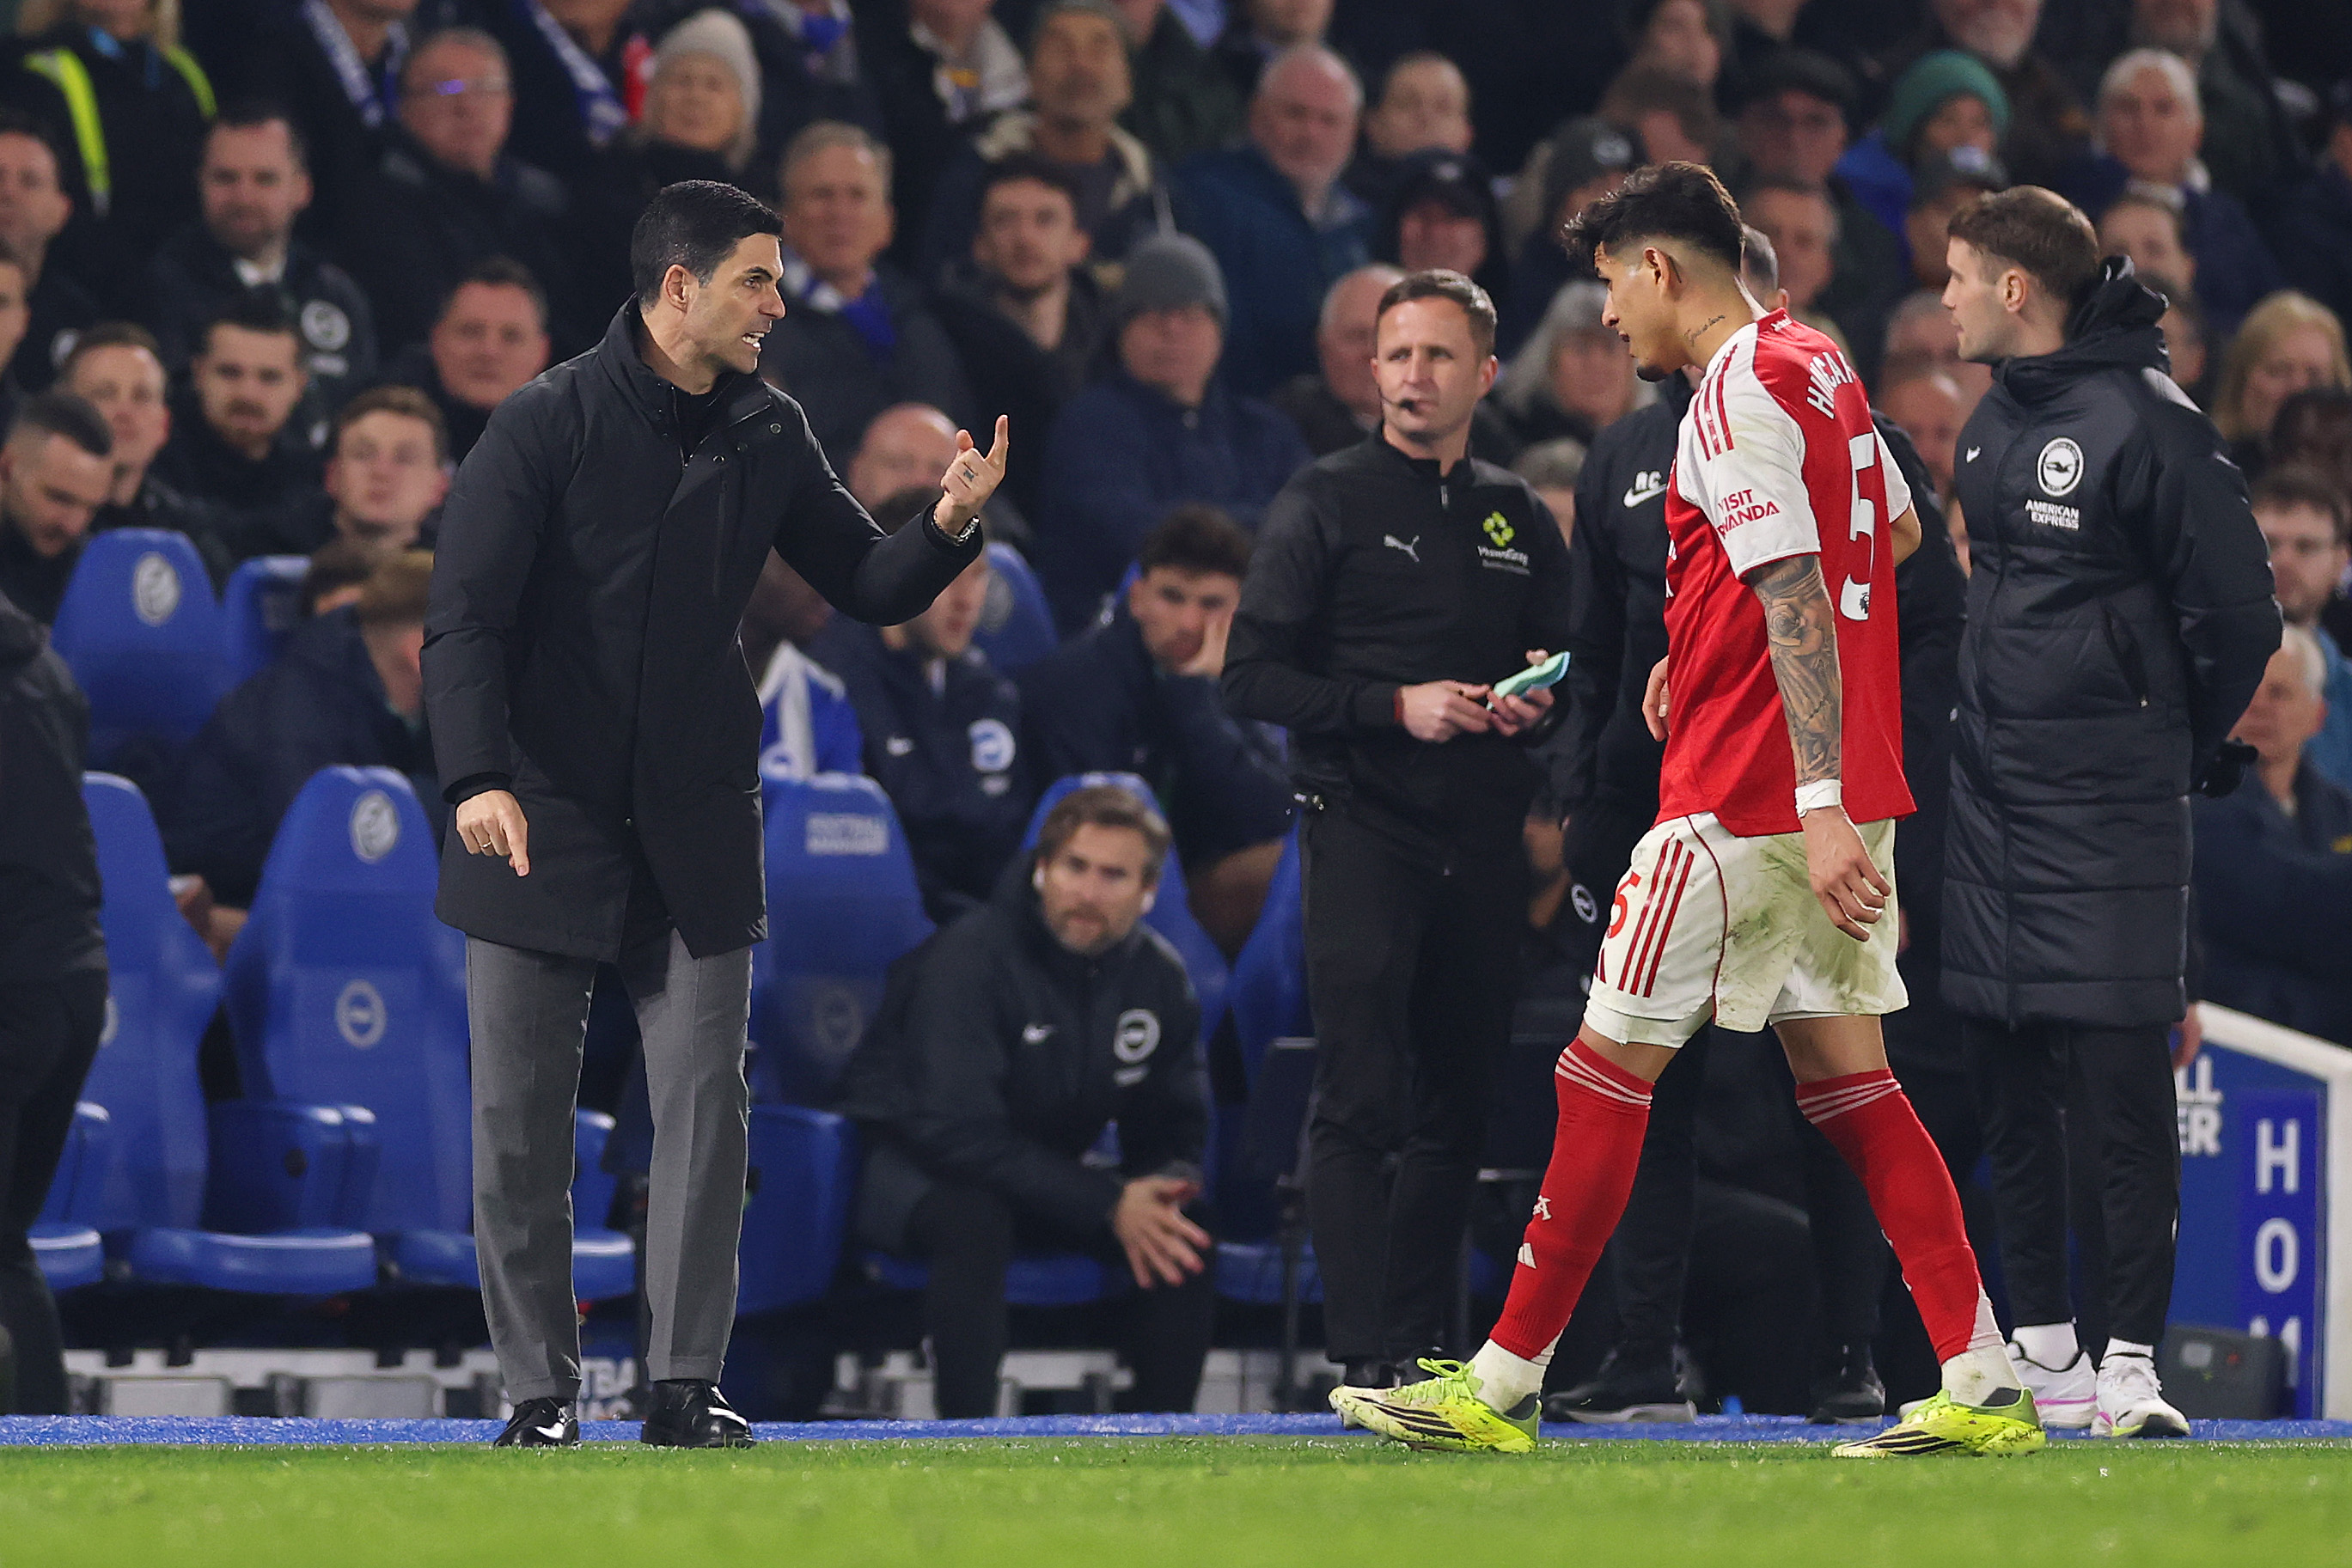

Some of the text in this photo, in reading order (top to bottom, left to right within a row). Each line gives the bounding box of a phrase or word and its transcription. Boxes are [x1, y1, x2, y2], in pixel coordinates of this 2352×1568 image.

[1718, 488, 1753, 515] VISIT
[2025, 499, 2080, 520] AMERICAN
[1839, 431, 1875, 621] 5
[2031, 510, 2080, 531] EXPRESS
[1605, 870, 1642, 939] 5
